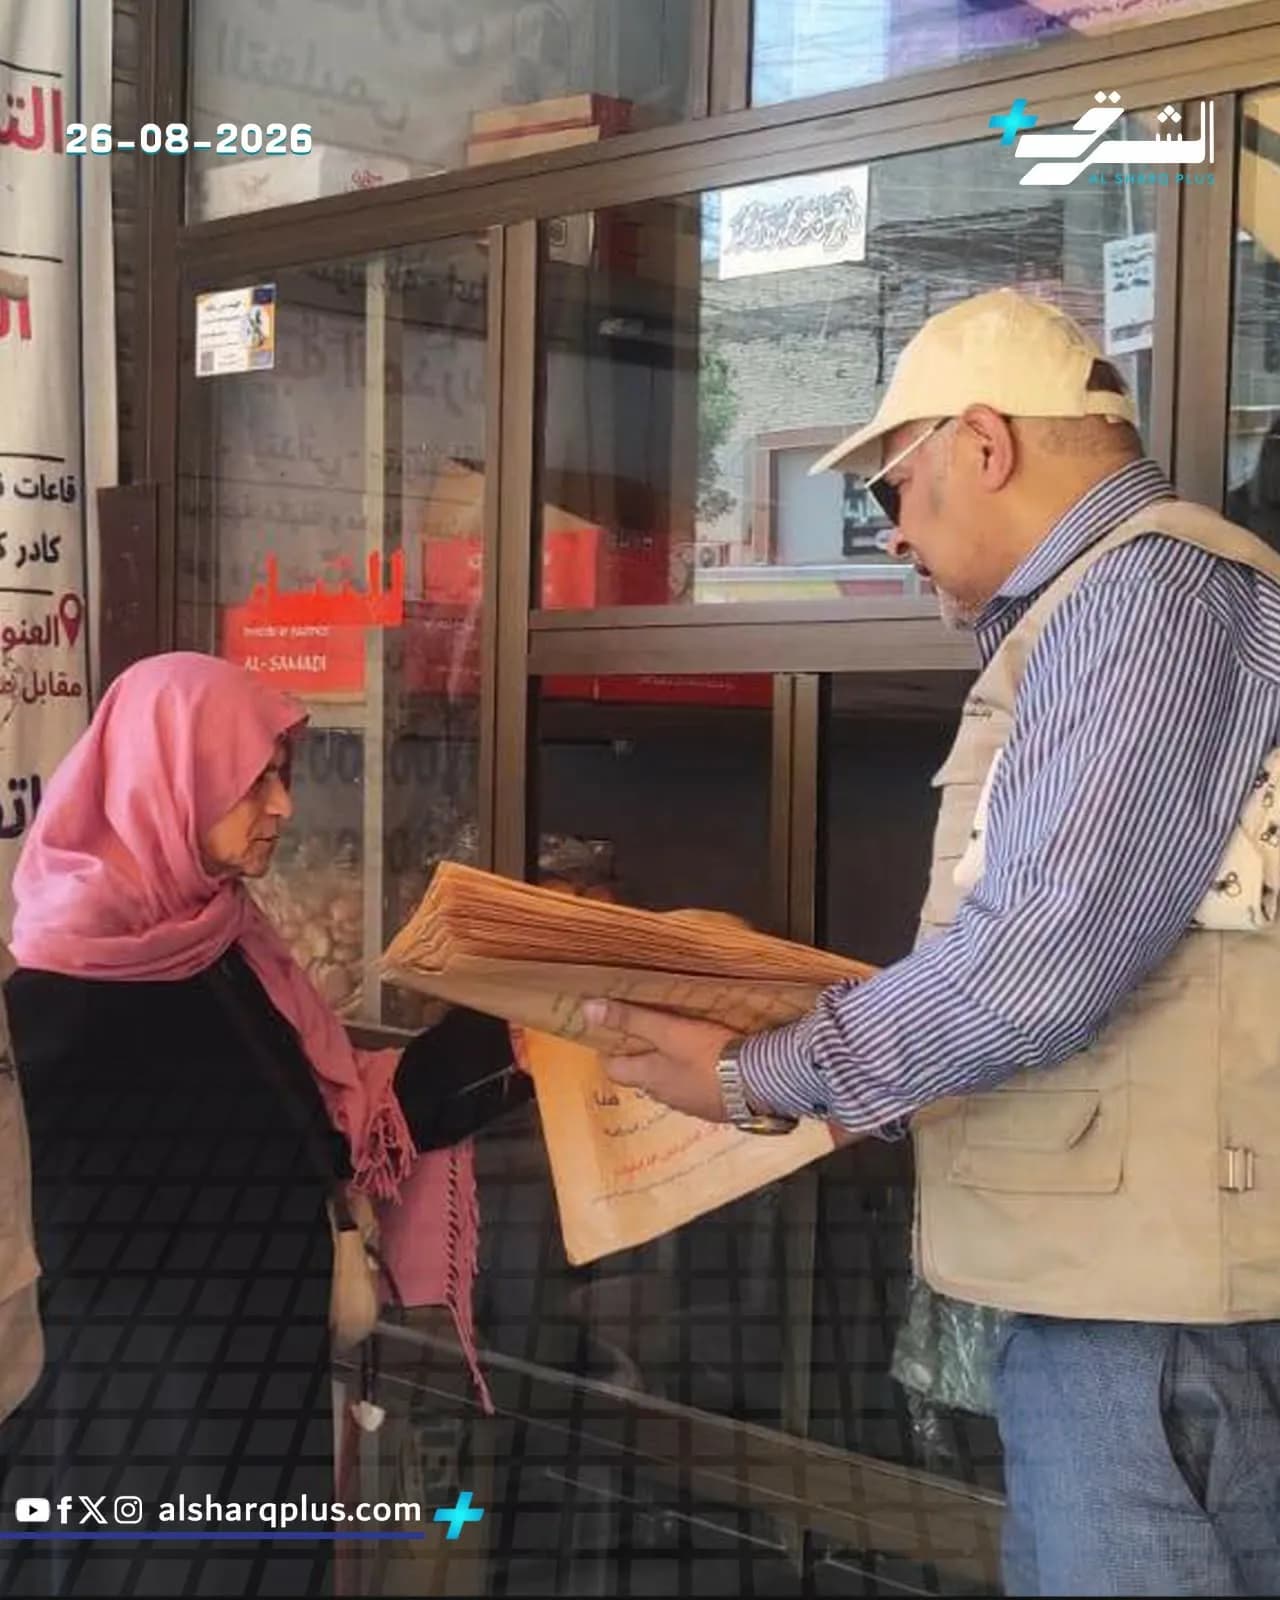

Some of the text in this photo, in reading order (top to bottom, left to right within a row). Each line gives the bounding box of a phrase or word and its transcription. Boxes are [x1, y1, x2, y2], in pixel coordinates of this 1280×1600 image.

[0, 86, 63, 153] الت
[14, 472, 76, 503] قاعات
[15, 531, 62, 568] كادر
[2, 614, 60, 653] العنو
[22, 669, 82, 704] مقابل
